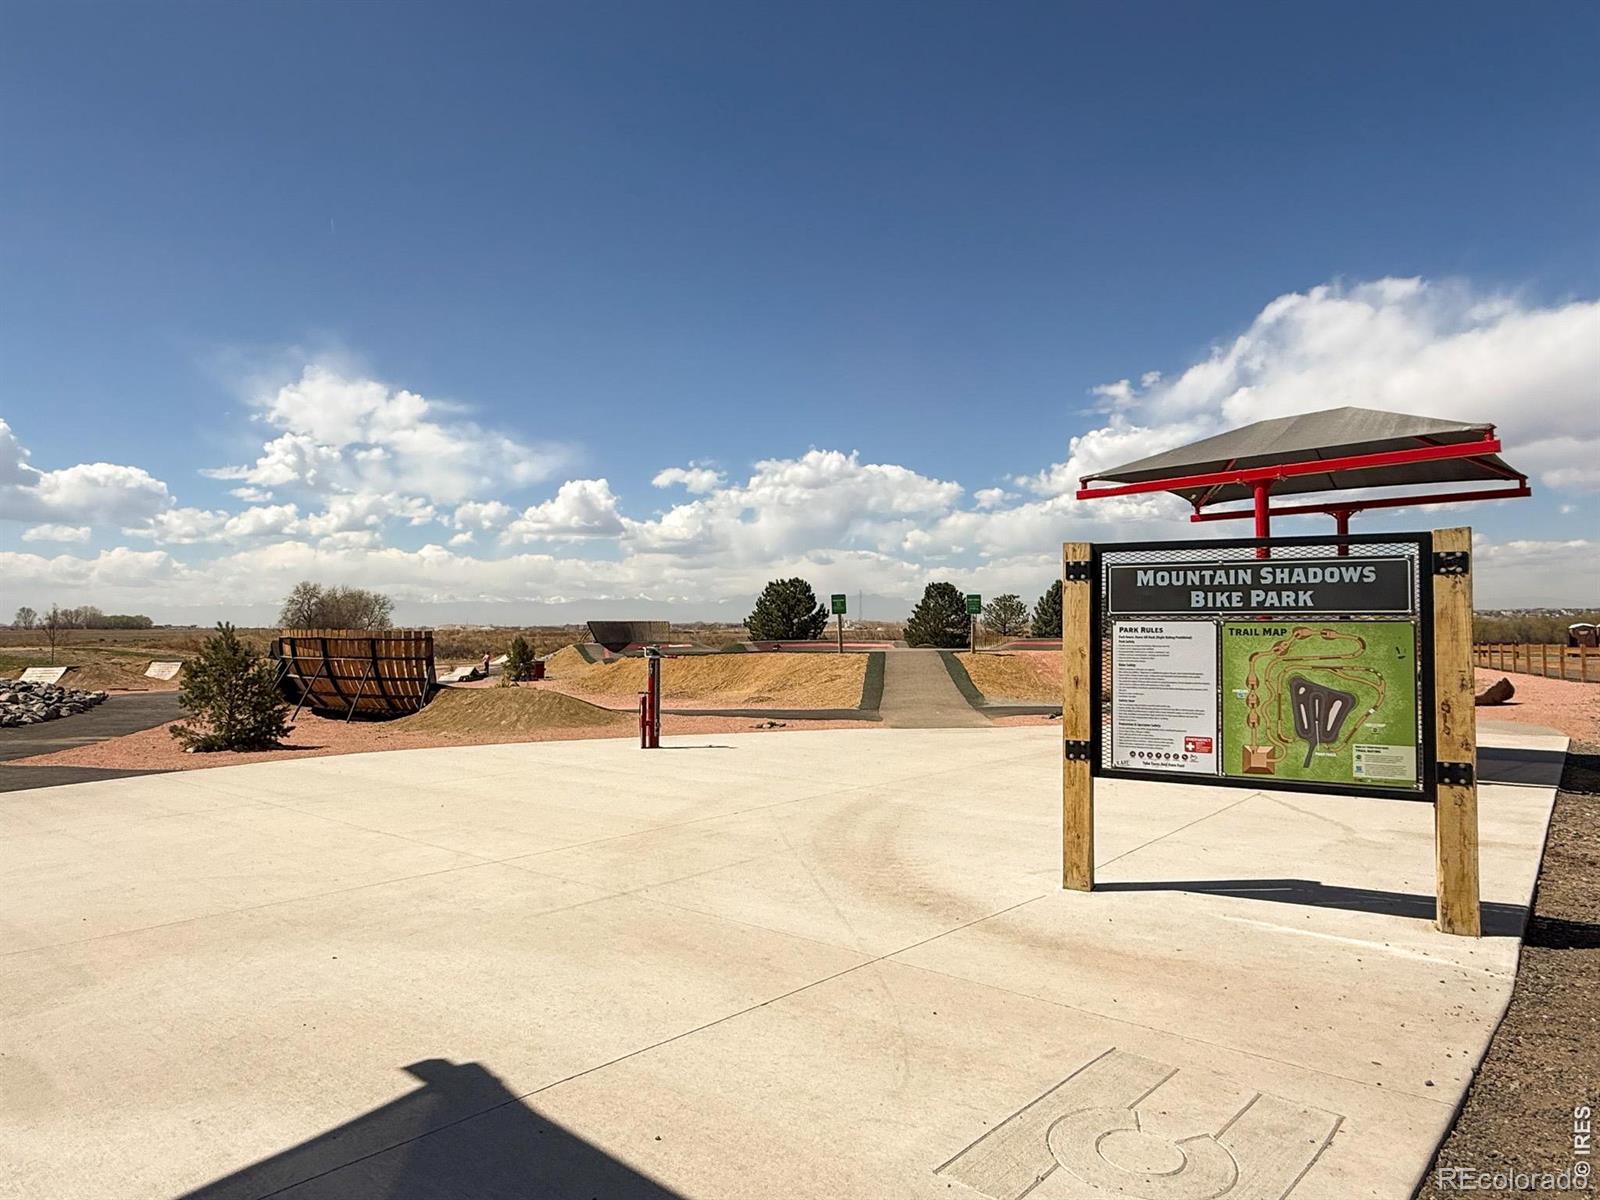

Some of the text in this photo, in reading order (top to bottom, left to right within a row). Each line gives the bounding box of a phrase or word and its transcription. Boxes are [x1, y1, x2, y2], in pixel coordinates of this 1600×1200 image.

[1136, 565, 1377, 587] MOUNTAIN SHADOWS
[1190, 589, 1314, 608] BIKE PARK
[1228, 627, 1288, 637] TRAIL MAP
